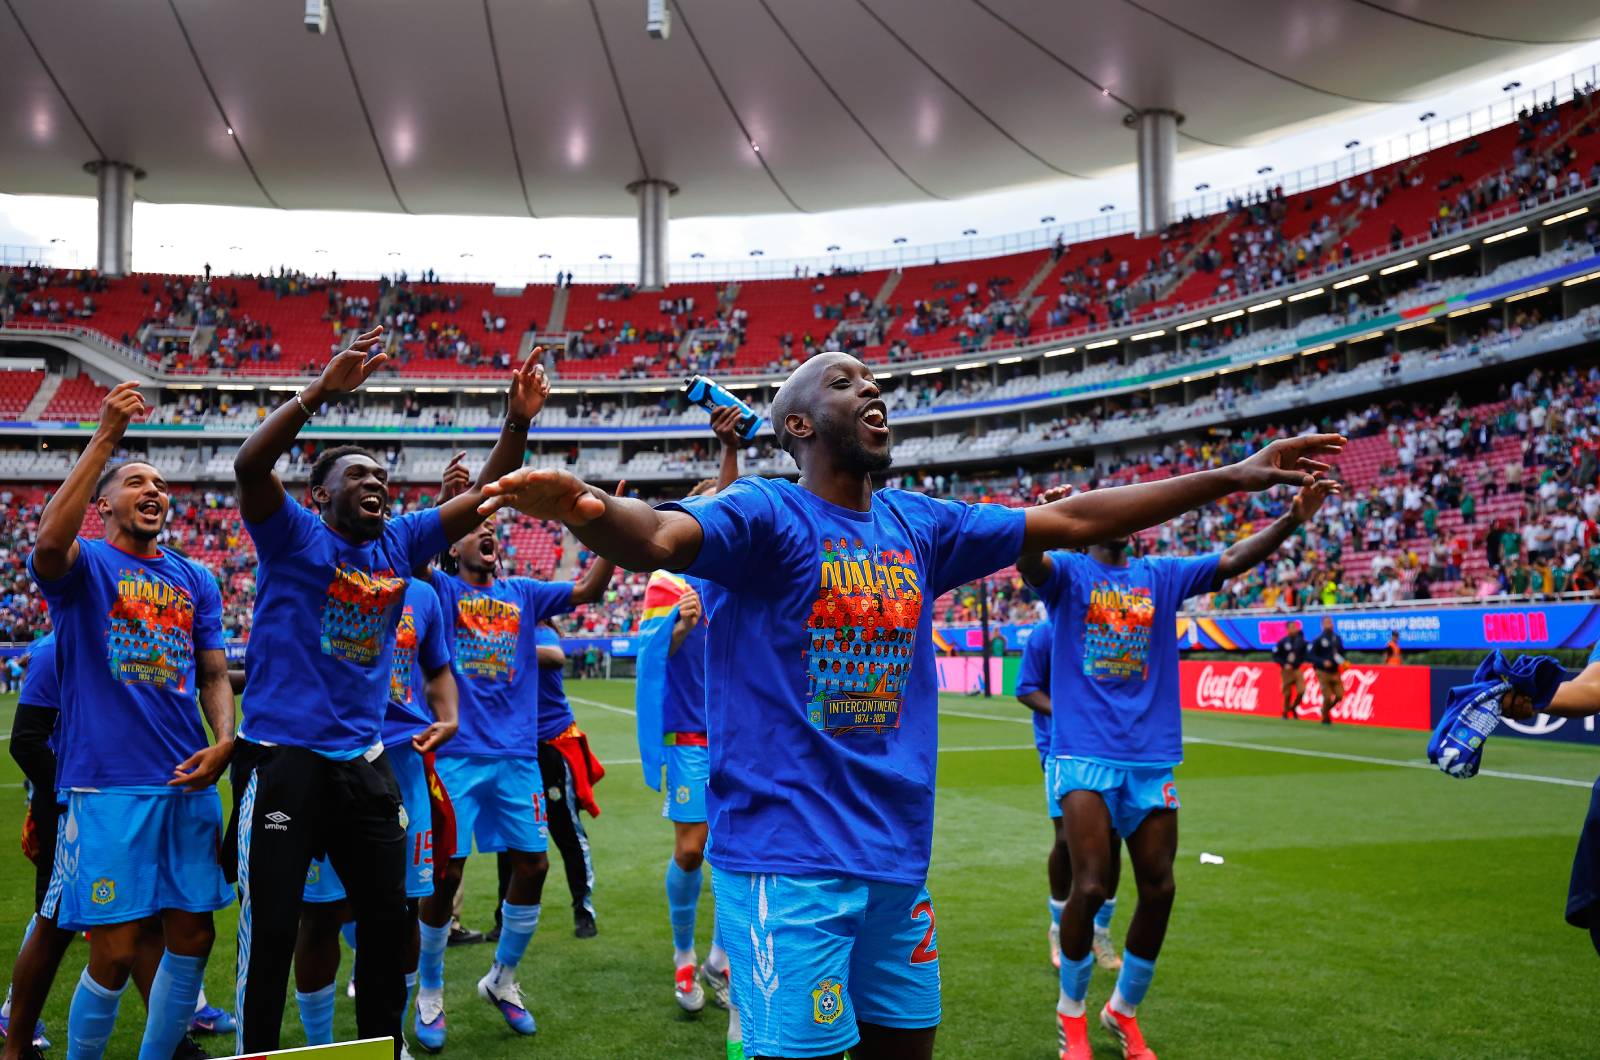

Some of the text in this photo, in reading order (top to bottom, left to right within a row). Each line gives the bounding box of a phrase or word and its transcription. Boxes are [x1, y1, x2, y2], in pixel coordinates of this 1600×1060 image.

[1337, 615, 1440, 631] FIFA WORLD CUP 2026
[1483, 611, 1549, 642] CONGO DR
[854, 714, 869, 724] 1974
[264, 823, 288, 832] umbro
[910, 900, 938, 965] 2
